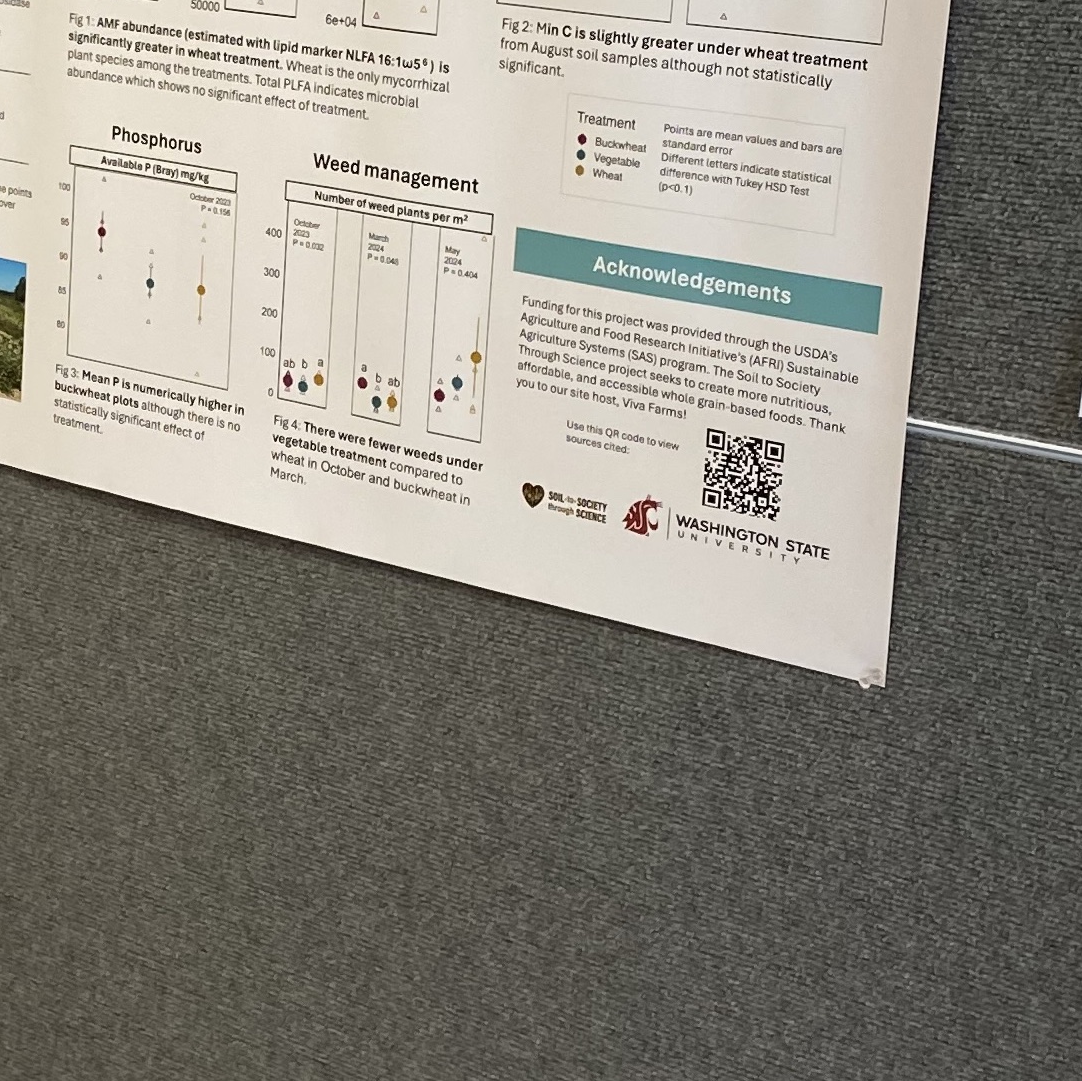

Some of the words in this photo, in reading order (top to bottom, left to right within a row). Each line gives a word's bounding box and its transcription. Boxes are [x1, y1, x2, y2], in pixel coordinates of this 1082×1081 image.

[502, 17, 520, 35] Fig
[521, 20, 534, 34] 2:
[536, 21, 559, 36] Min
[562, 25, 572, 38] C
[574, 26, 586, 40] is
[588, 29, 640, 49] slightly
[641, 36, 695, 52] greater
[697, 42, 741, 57] under
[743, 45, 789, 62] wheat
[792, 51, 869, 71] treatment
[500, 37, 529, 52] from
[530, 41, 574, 59] August
[576, 49, 599, 62] soil
[601, 52, 658, 69] samples
[660, 57, 722, 78] although
[725, 66, 750, 79] not
[752, 68, 833, 91] statistically
[577, 110, 636, 131] Treatment
[111, 125, 202, 154] Phosphorus
[594, 136, 647, 153] Buckwheat
[313, 152, 361, 175] Weed
[364, 164, 479, 194] management
[592, 167, 623, 182] Wheat
[593, 152, 641, 169] Vegetable
[265, 227, 283, 239] 400
[263, 266, 281, 279] 300
[592, 255, 791, 304] Acknowledgements
[261, 306, 278, 319] 200
[522, 295, 564, 316] Funding
[565, 303, 581, 316] for
[582, 307, 603, 320] this
[604, 313, 644, 328] project
[645, 320, 669, 333] was
[671, 325, 722, 342] provided
[724, 332, 769, 352] through
[771, 341, 792, 355] the
[794, 344, 838, 363] USDA's
[273, 414, 289, 431] Fig
[290, 419, 303, 431] 4:
[303, 421, 336, 439] There
[337, 431, 366, 446] were
[368, 436, 402, 454] fewer
[403, 446, 443, 464] weeds
[446, 456, 484, 472] under
[675, 513, 779, 549] WASHINGTON
[785, 539, 831, 561] STATE
[677, 530, 801, 565] UNIVERSITY
